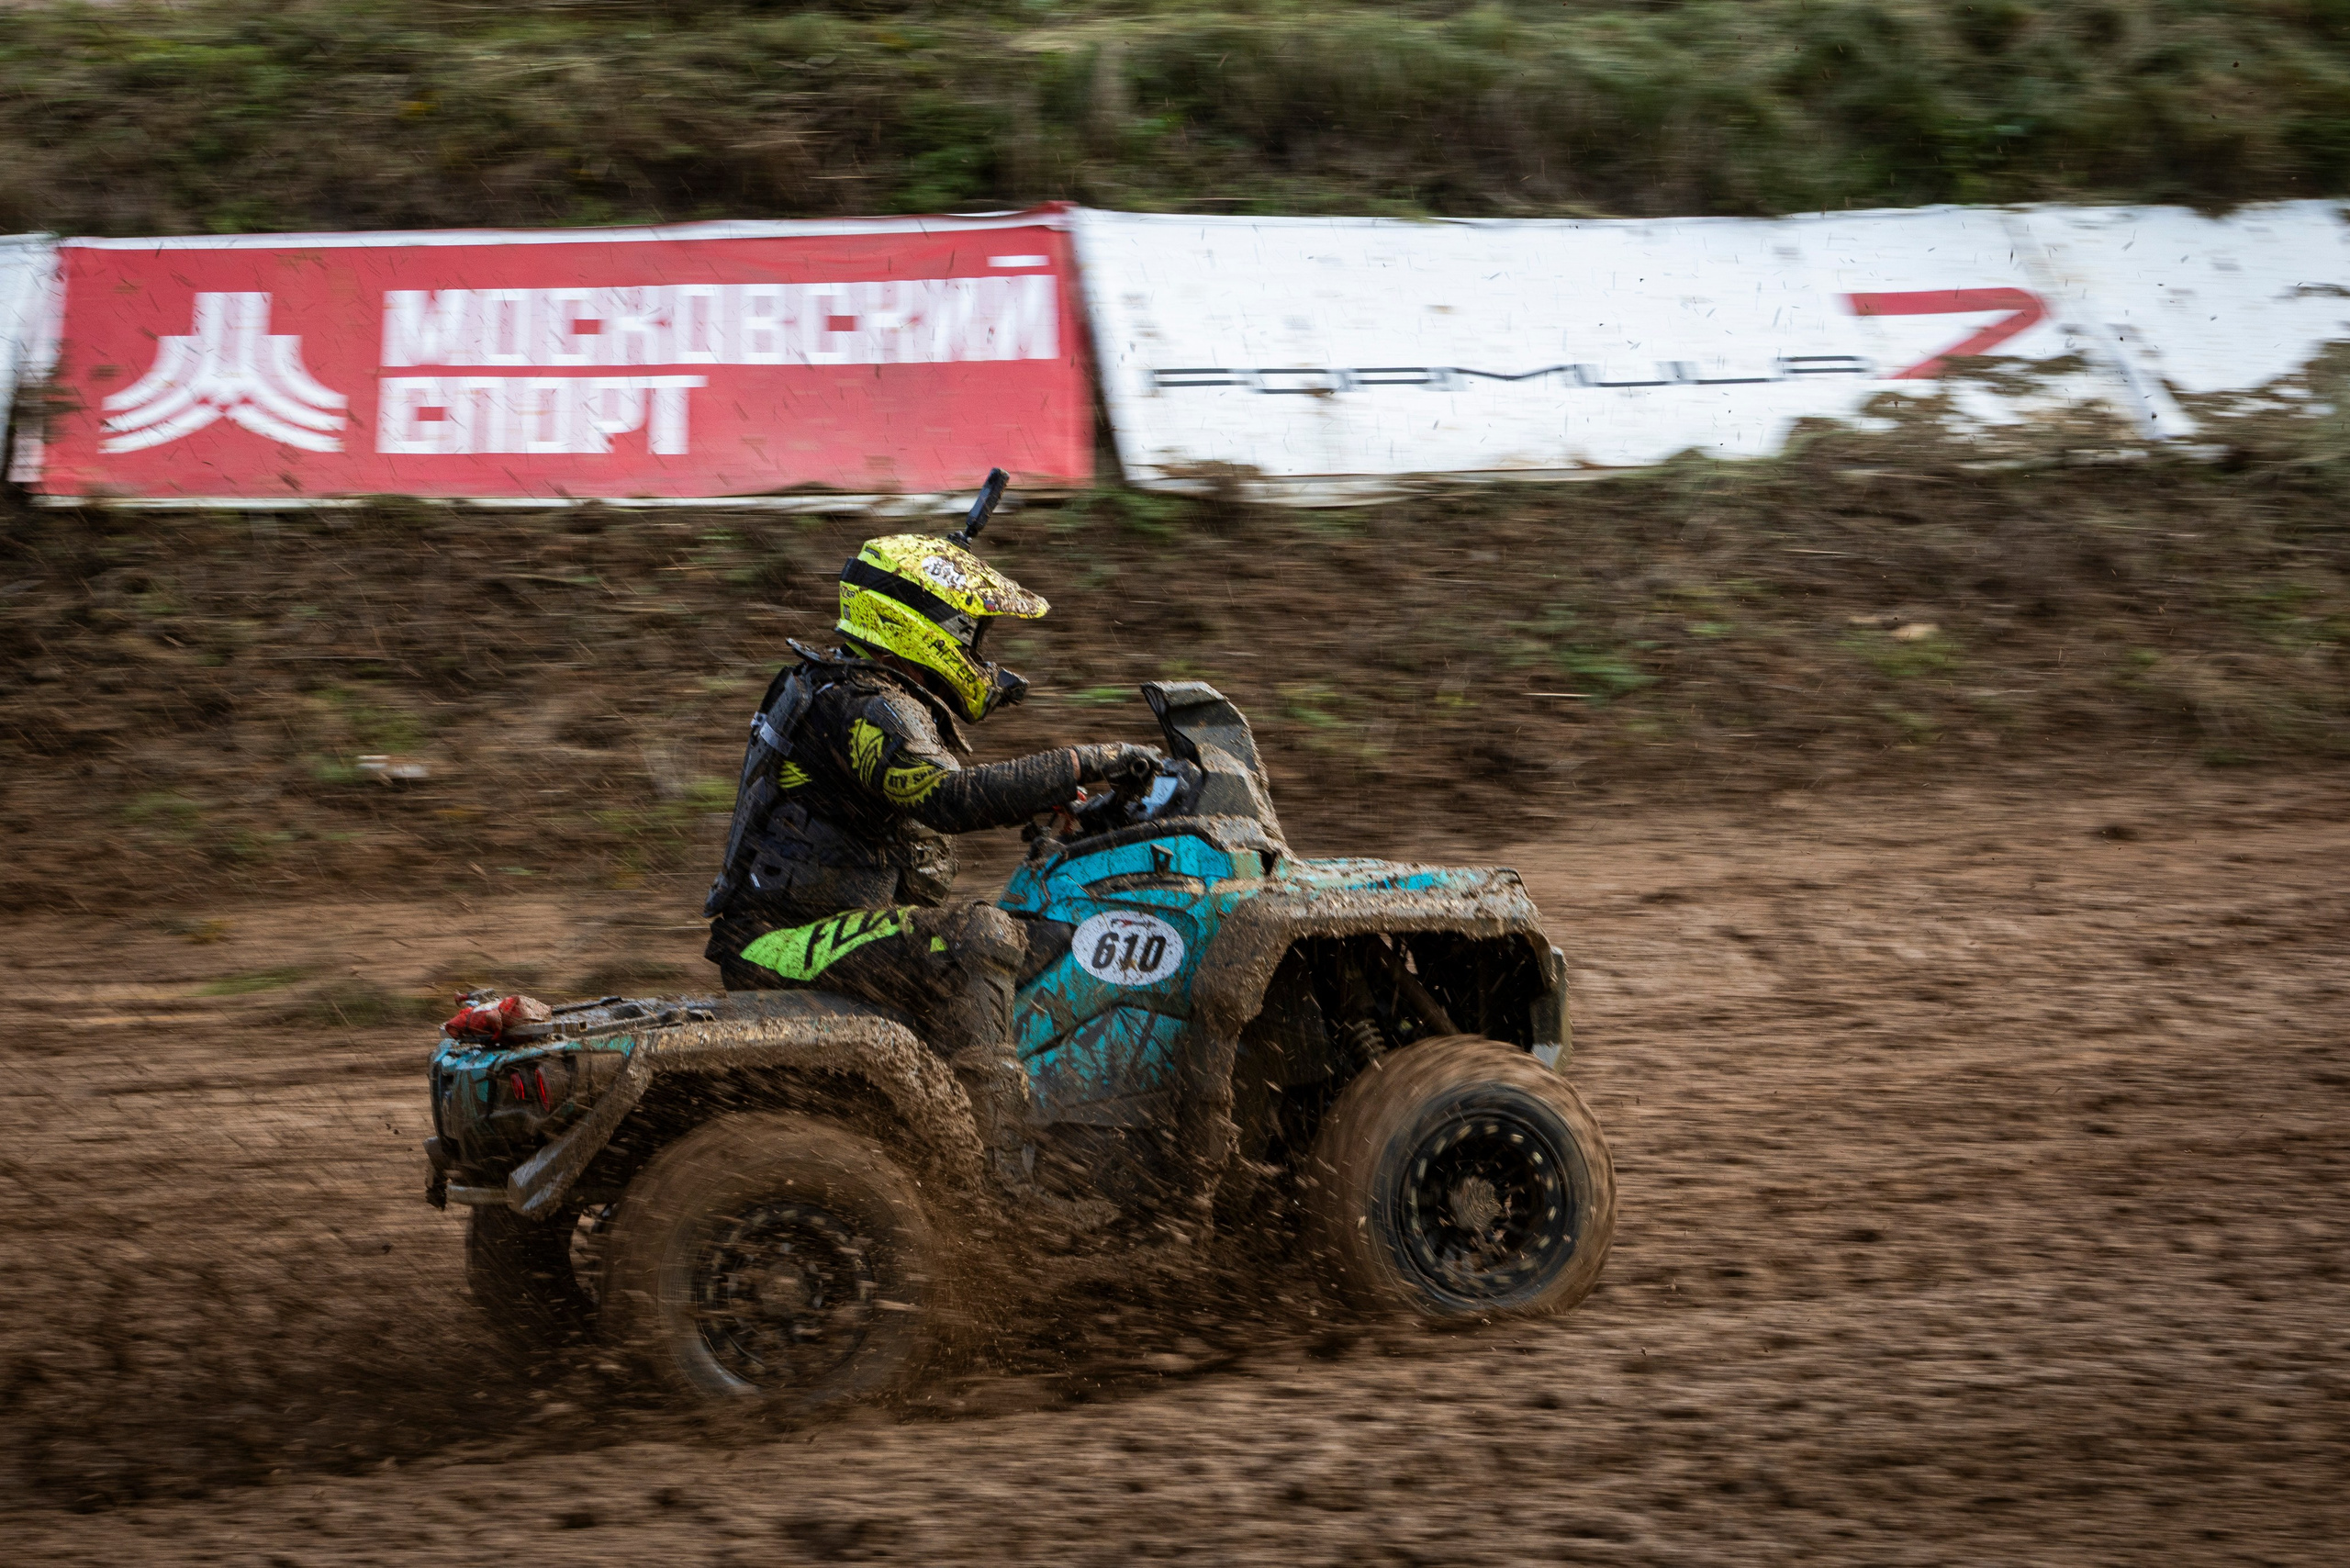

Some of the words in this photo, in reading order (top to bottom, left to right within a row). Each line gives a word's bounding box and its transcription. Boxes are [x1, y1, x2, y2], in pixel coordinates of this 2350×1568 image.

[379, 253, 1059, 366] МОСКОВСКИЙ
[375, 375, 709, 454] СПОРТ
[1091, 932, 1167, 972] 610
